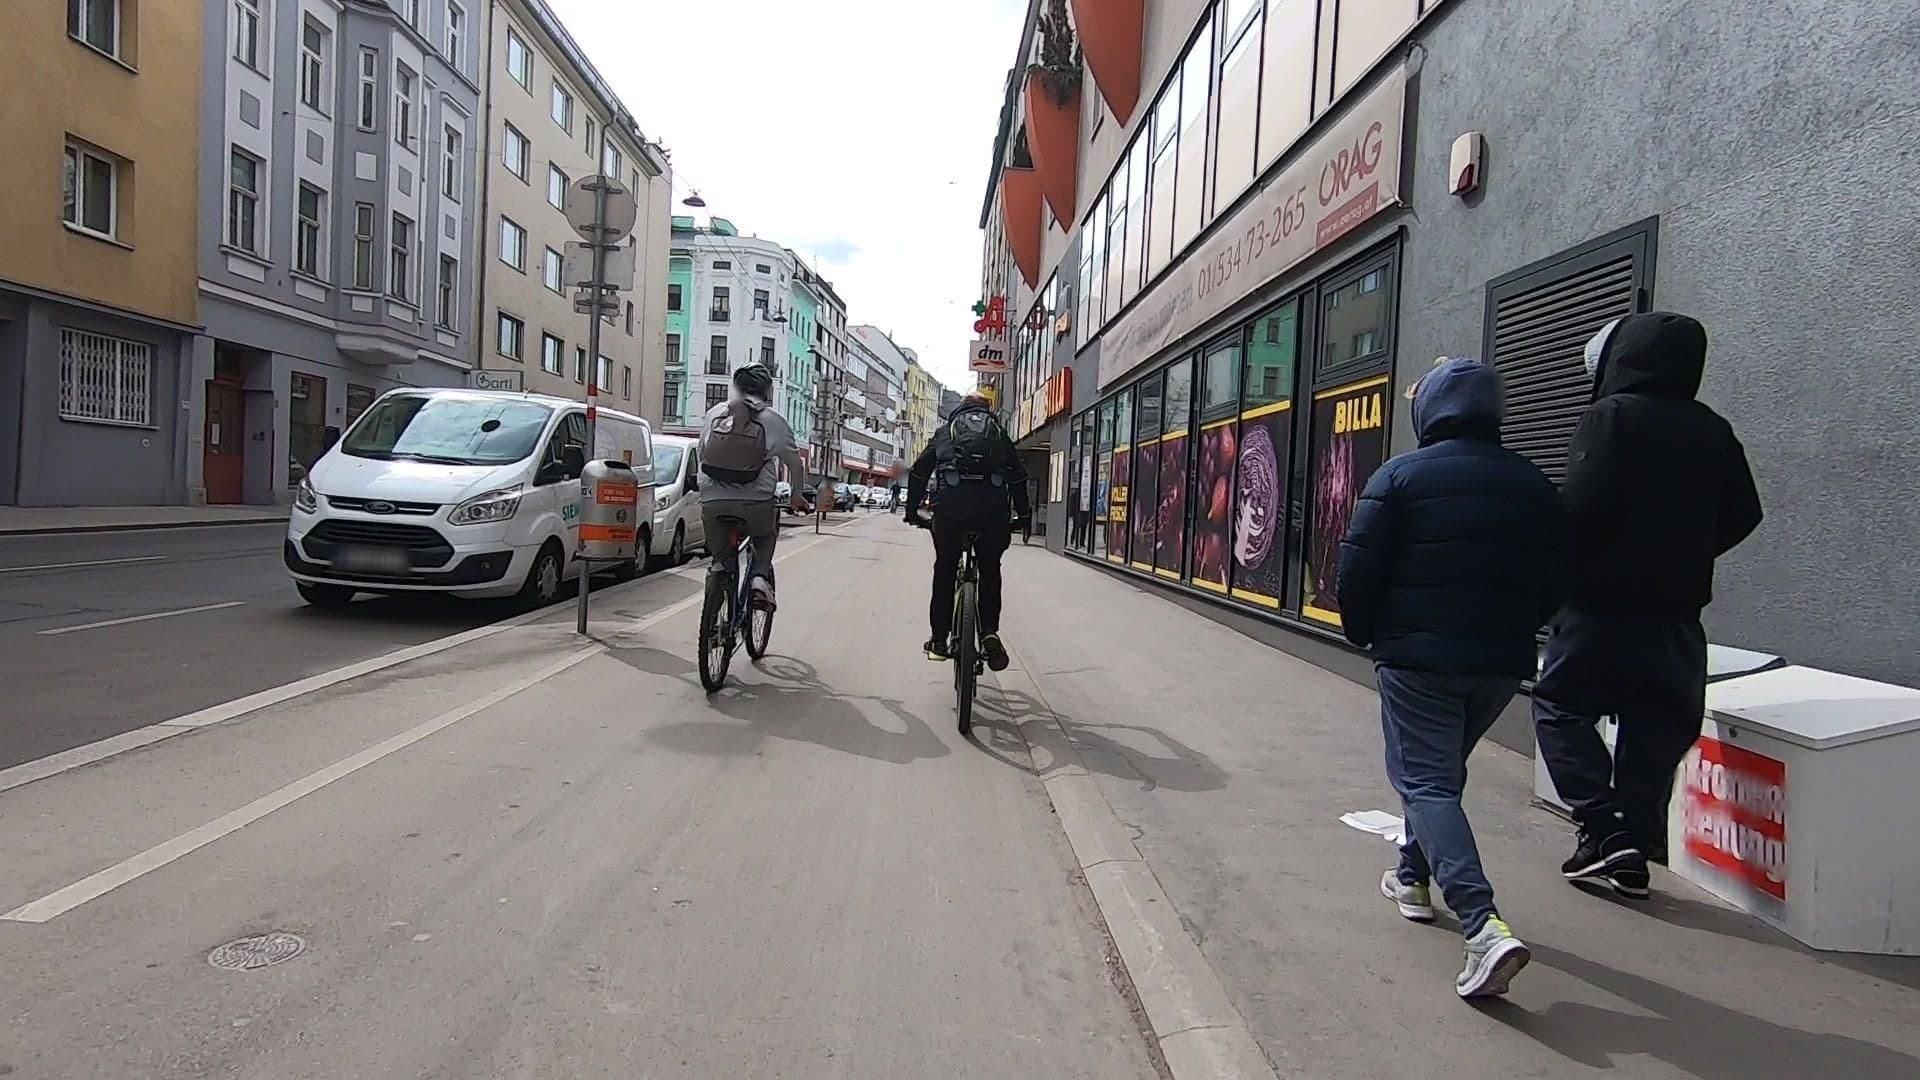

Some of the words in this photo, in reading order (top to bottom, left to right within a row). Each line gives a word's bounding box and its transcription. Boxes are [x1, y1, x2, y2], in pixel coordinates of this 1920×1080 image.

[1198, 240, 1241, 299] 01/534
[1246, 184, 1306, 265] 73-265
[978, 345, 1003, 360] dm
[1334, 392, 1382, 434] BILLA
